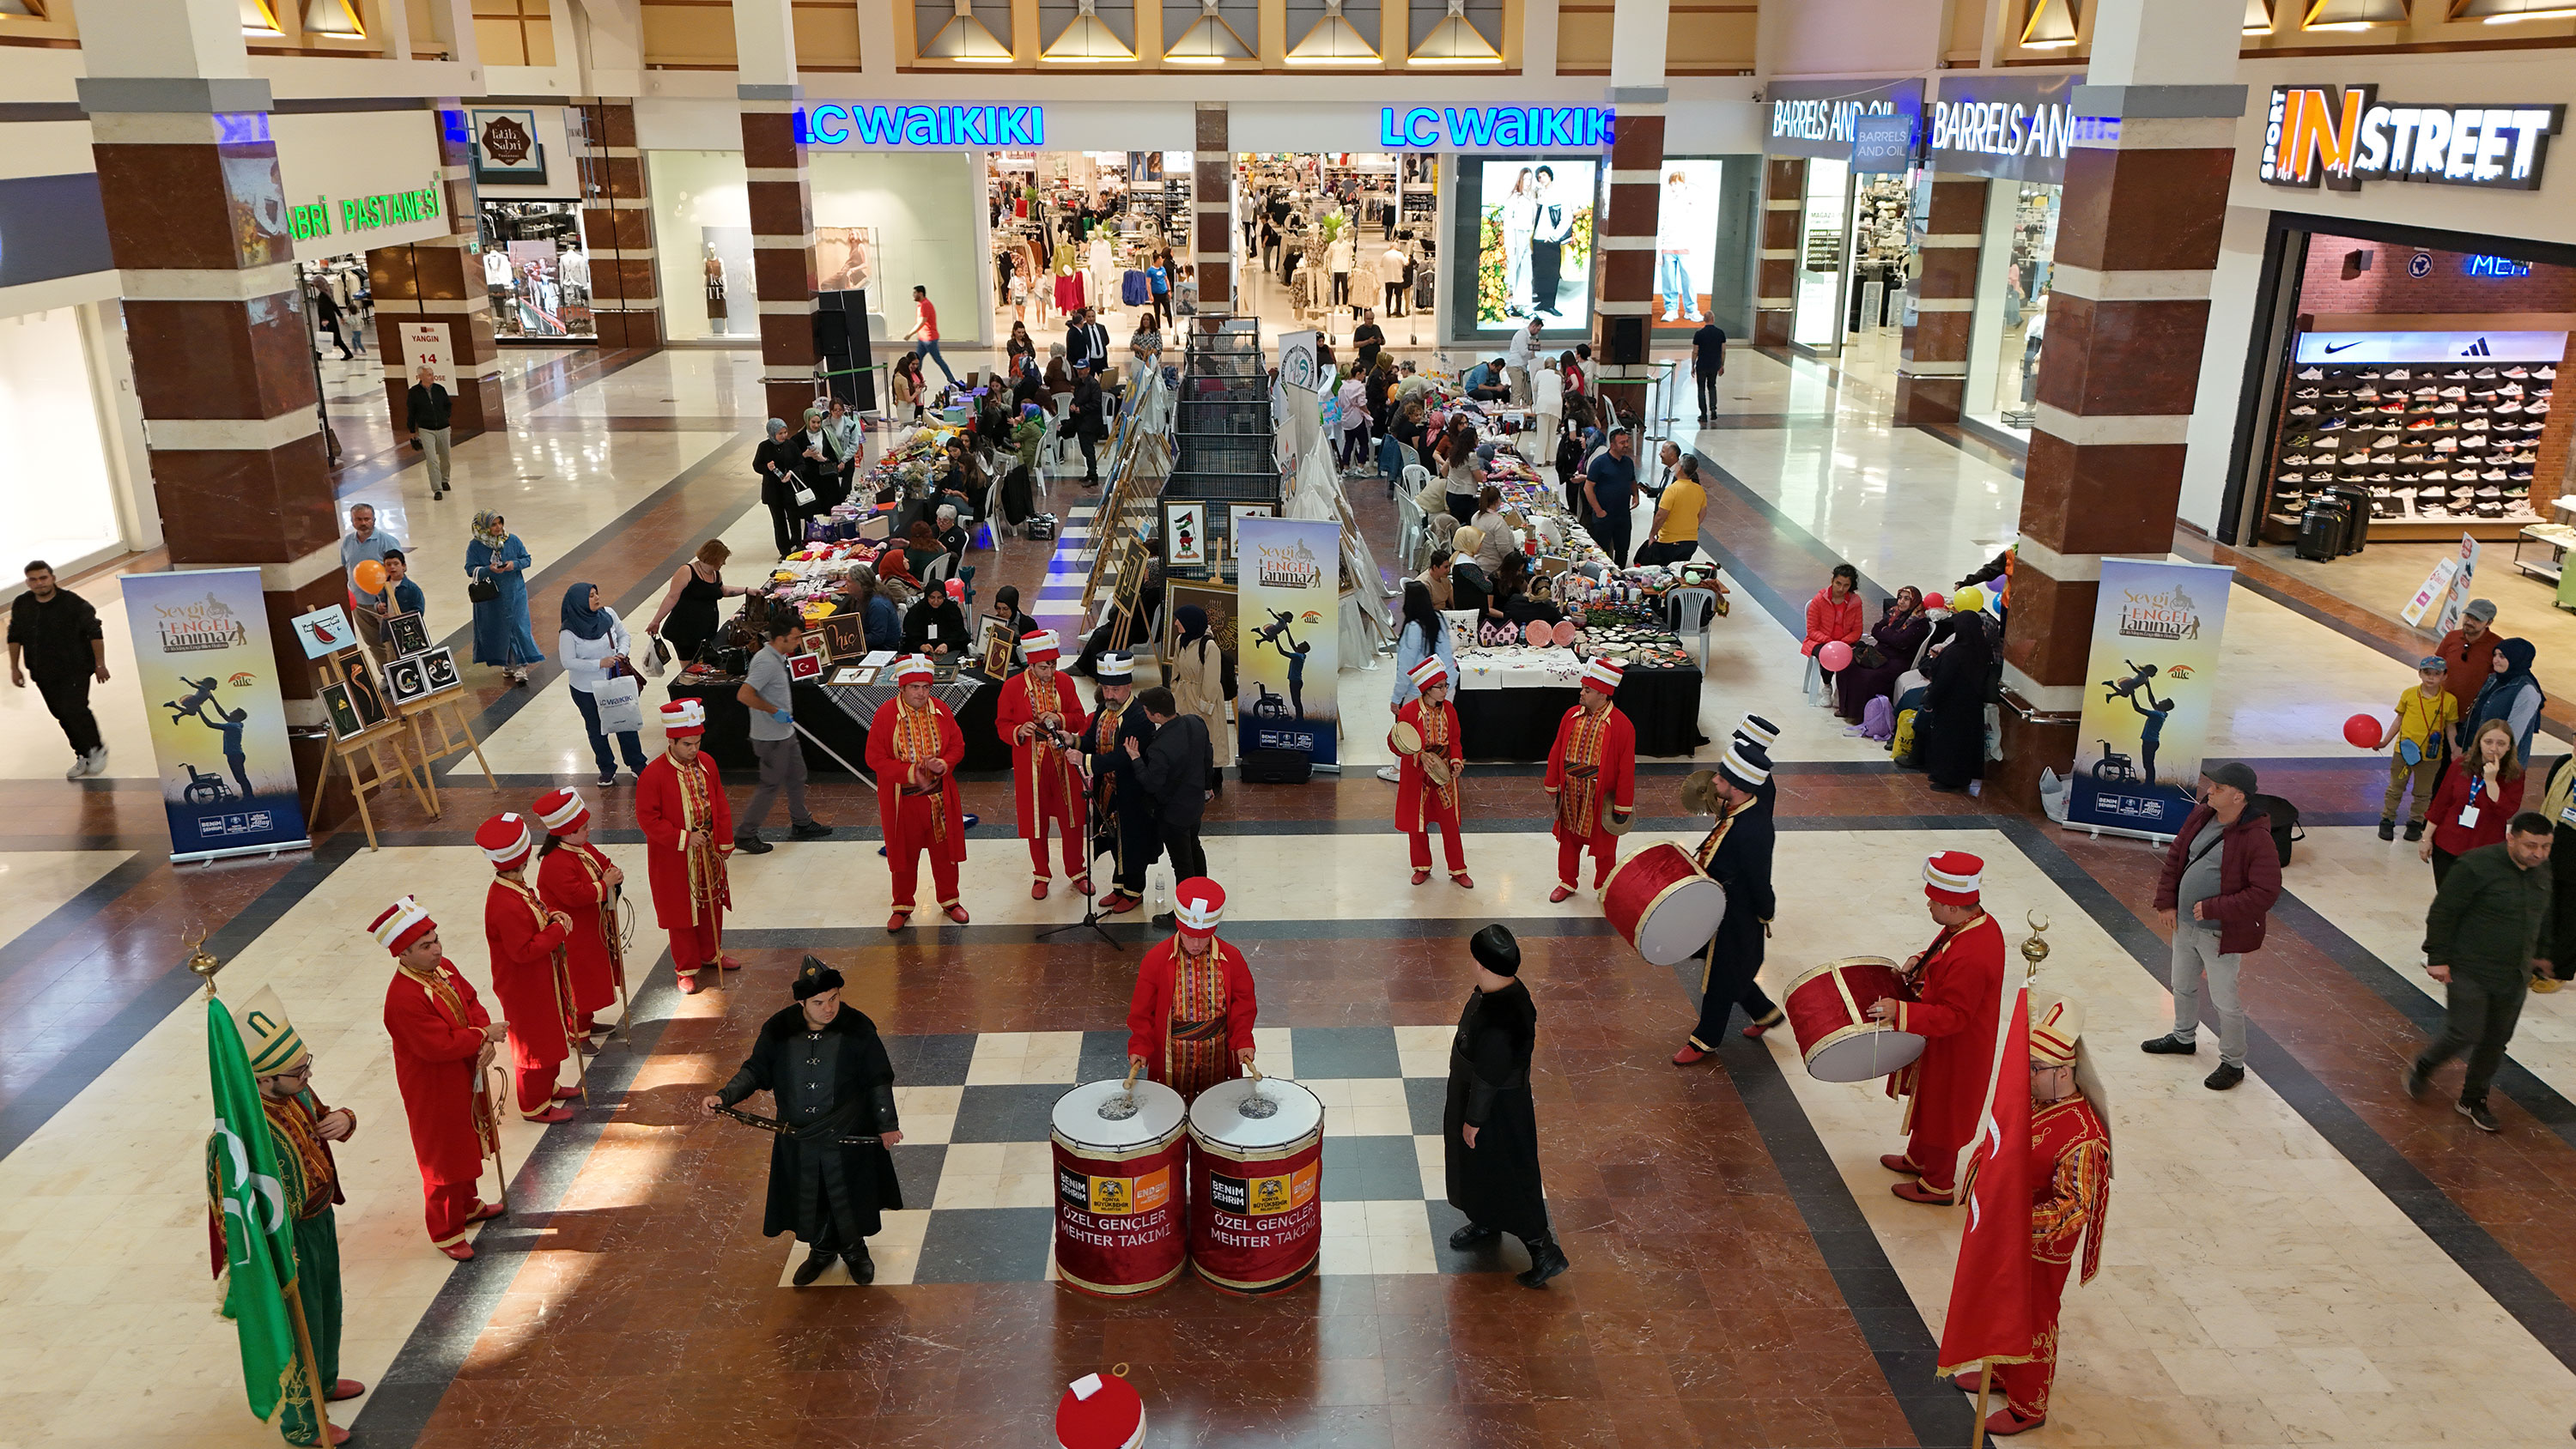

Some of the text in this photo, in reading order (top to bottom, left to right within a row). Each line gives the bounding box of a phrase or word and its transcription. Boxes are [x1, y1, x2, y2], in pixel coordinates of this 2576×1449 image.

[1381, 107, 1440, 147] LC
[1772, 99, 1829, 141] BARRELS
[1932, 100, 2076, 159] BARRELS AN
[1858, 130, 1906, 142] BARRELS
[1857, 145, 1906, 157] AND OIL
[343, 180, 441, 233] PASTANESİ
[420, 353, 437, 364] 14
[1257, 542, 1294, 561] Sevgi
[1267, 560, 1315, 573] ENGEL
[2123, 587, 2170, 609] Sevgi
[153, 601, 205, 621] Sevgi
[2131, 607, 2191, 624] ENGEL
[170, 619, 235, 634] ENGEL
[1060, 1172, 1086, 1193] BENİM
[1060, 1182, 1087, 1202] ŞEHRİM
[1212, 1179, 1244, 1197] BENİM
[1212, 1190, 1244, 1206] ŞEHRİM
[1063, 1203, 1166, 1232] ÖZEL GENÇLER
[1214, 1202, 1315, 1232] ÖZEL GENÇLER
[1060, 1220, 1171, 1247] MEHTER TAKIMI
[1211, 1214, 1316, 1248] MEHTER TAKIMI
